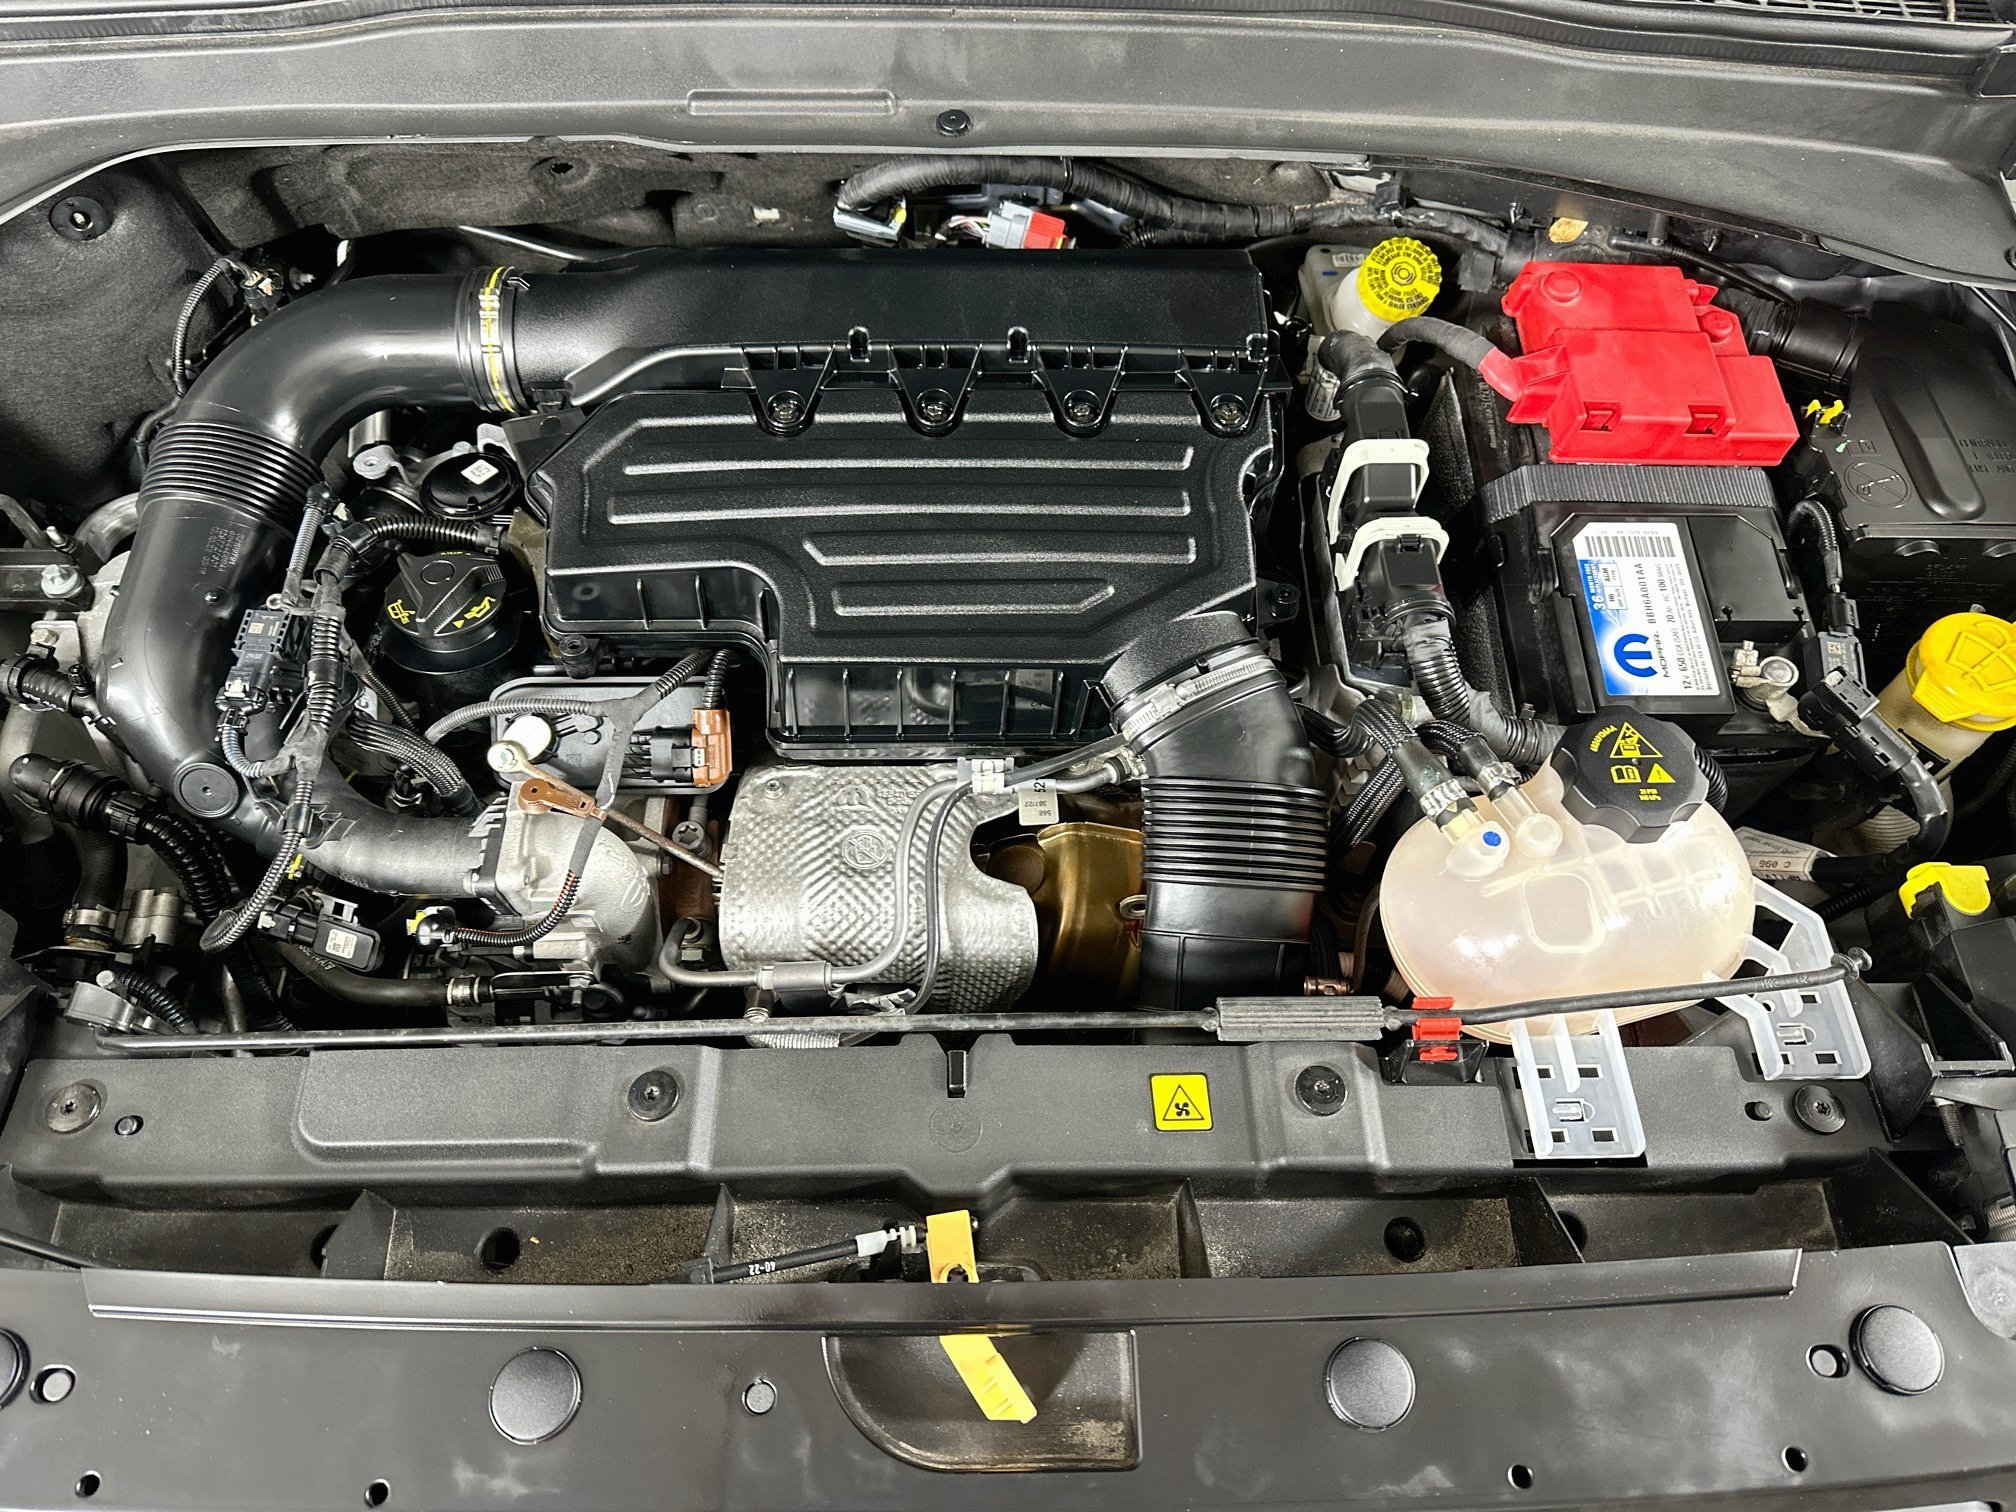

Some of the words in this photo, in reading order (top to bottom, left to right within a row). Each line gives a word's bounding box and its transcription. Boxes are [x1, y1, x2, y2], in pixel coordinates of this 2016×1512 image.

[1656, 578, 1667, 592] 100
[1591, 595, 1606, 611] 36
[1653, 633, 1671, 678] MOPAR
[1676, 657, 1688, 672] 650
